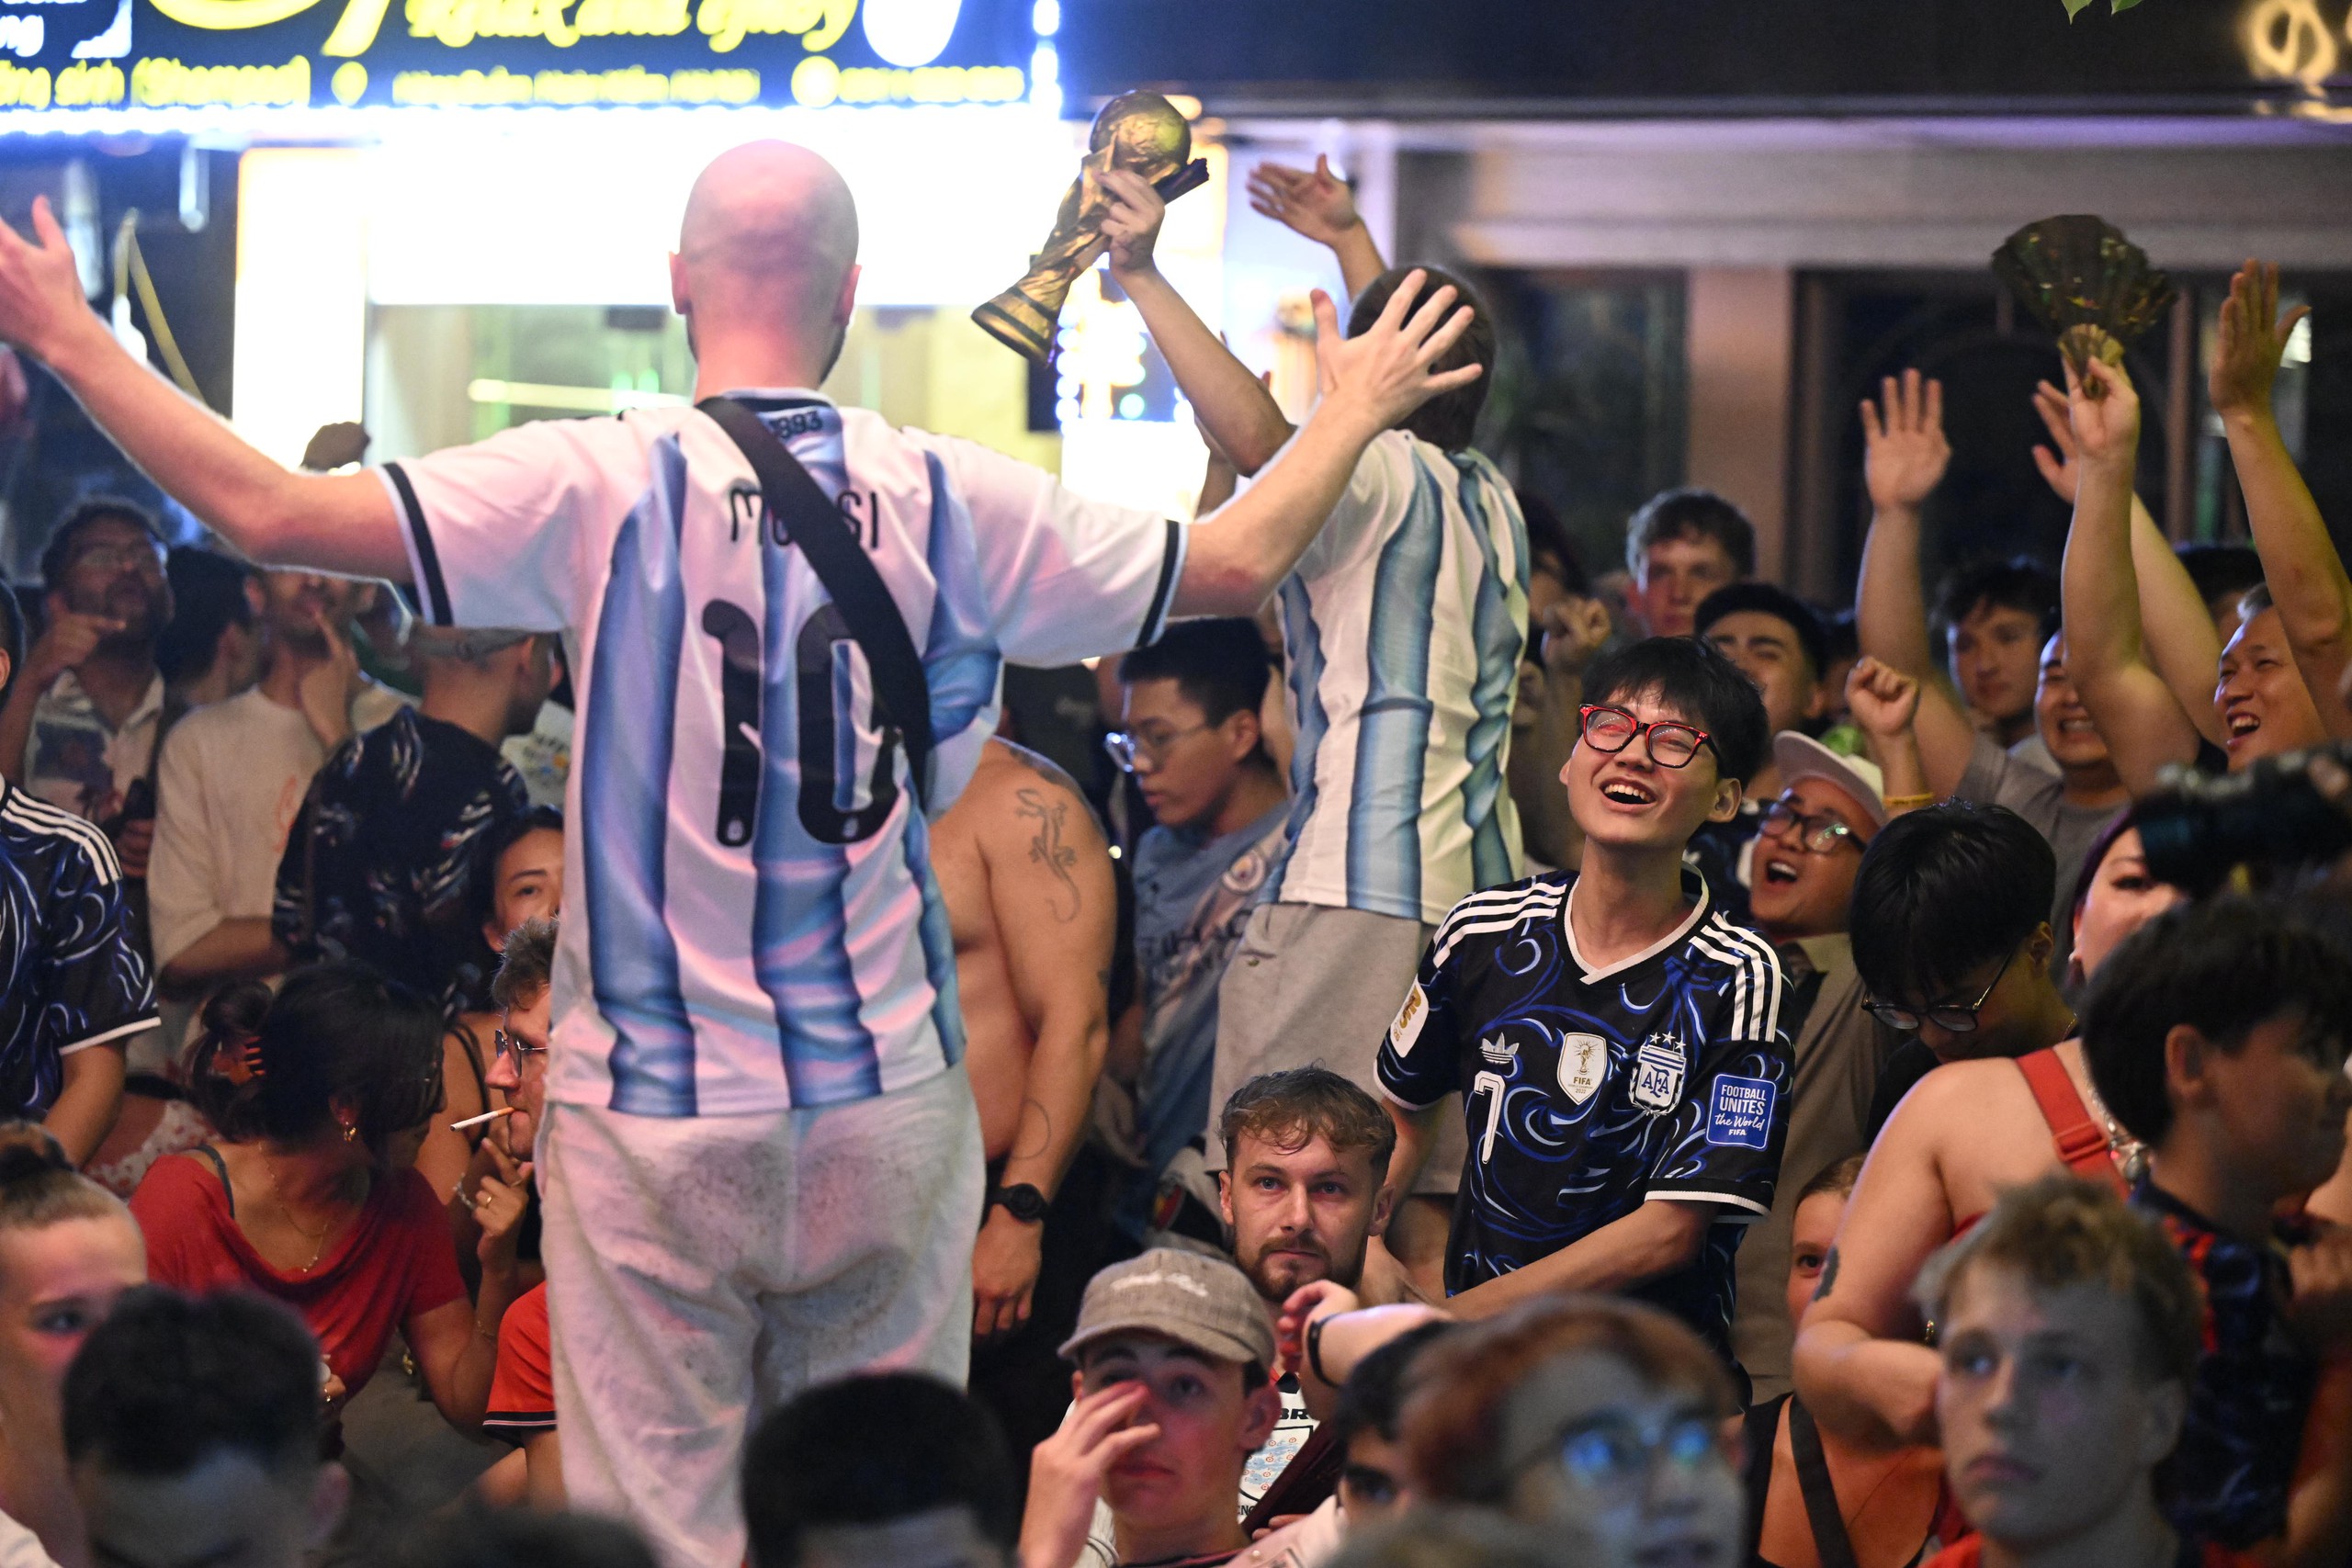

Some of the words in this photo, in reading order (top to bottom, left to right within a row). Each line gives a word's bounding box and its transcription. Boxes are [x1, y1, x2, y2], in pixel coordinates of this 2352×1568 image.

[702, 598, 899, 847] 10
[1573, 1077, 1591, 1086] FIFA
[1641, 1064, 1670, 1099] AFA
[1721, 1084, 1766, 1100] FOOTBALL
[1719, 1096, 1765, 1115] UNITES
[1474, 1070, 1506, 1164] 7
[1714, 1112, 1733, 1126] the
[1733, 1115, 1766, 1132] World
[1728, 1128, 1747, 1136] FIFA
